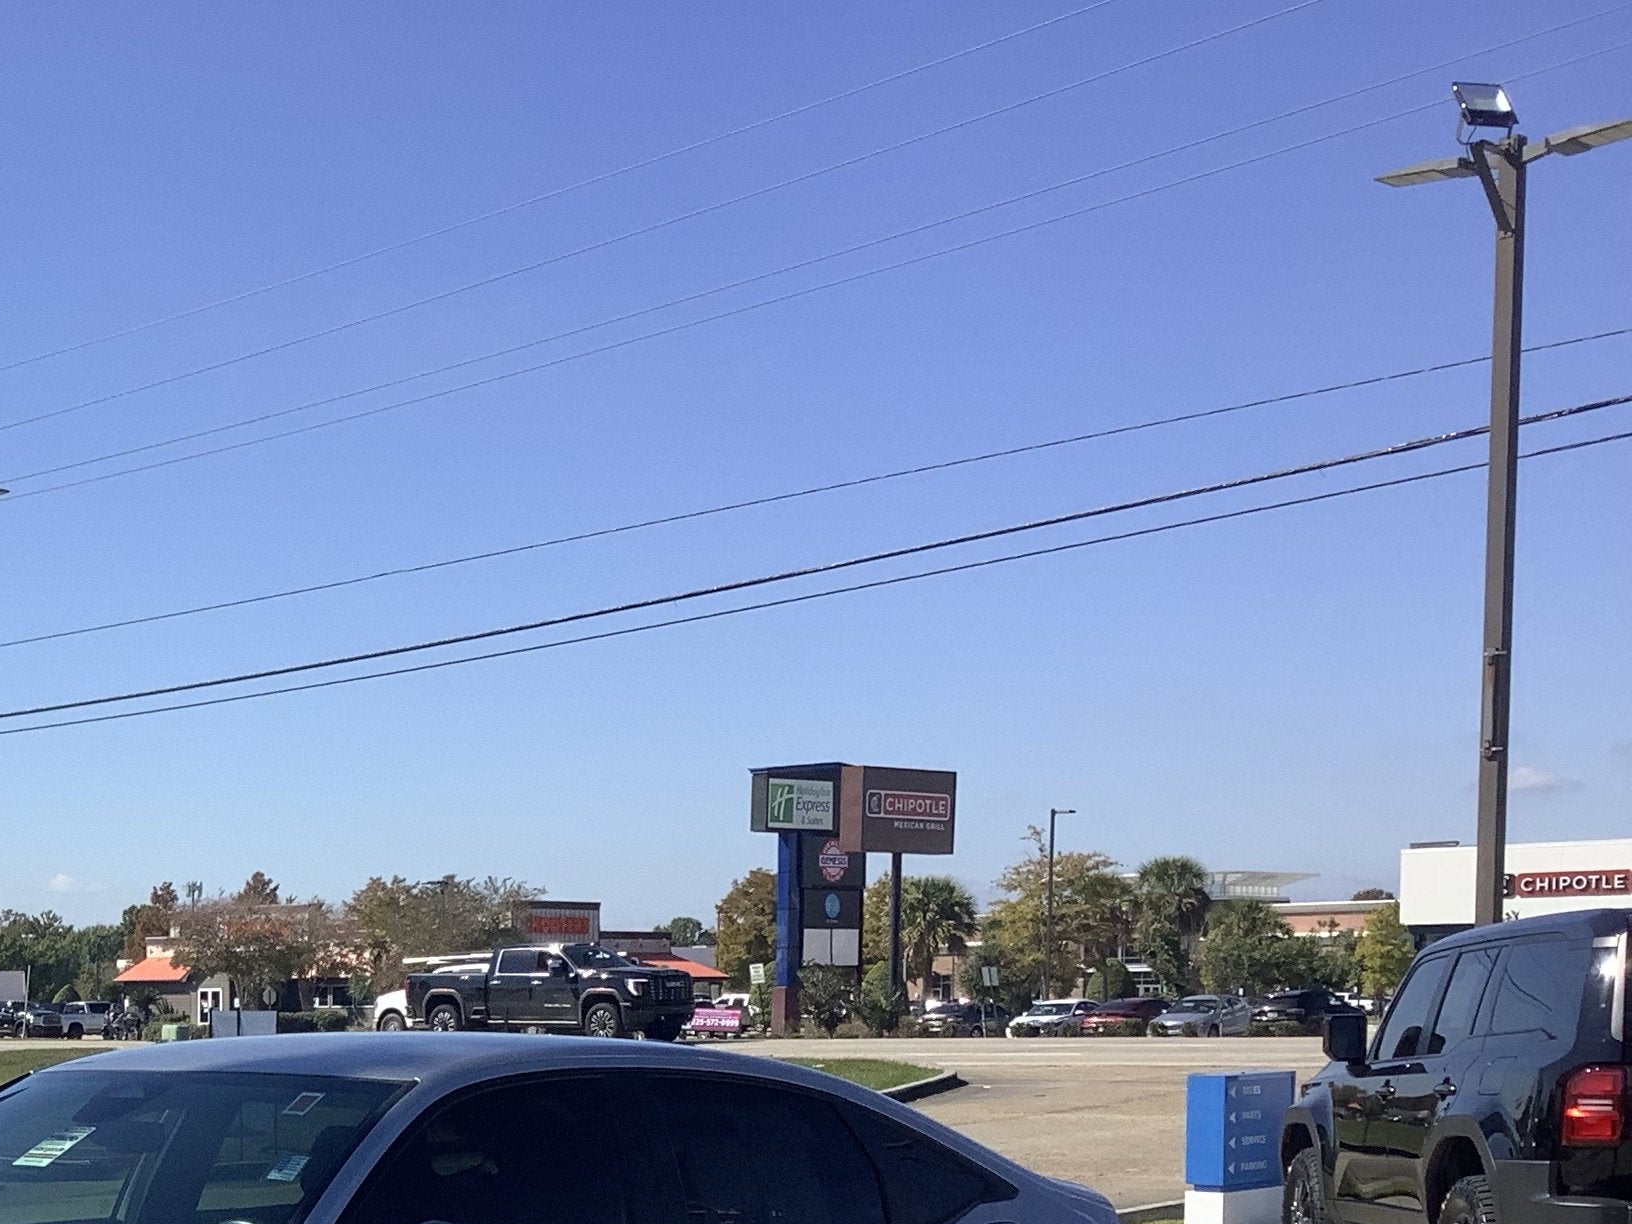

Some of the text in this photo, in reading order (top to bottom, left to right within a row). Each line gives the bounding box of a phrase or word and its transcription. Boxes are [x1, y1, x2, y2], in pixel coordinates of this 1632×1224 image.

[796, 796, 831, 815] Express
[885, 797, 946, 814] CHIPOTLE
[893, 821, 945, 831] MEXICAN GRILL
[1520, 874, 1626, 892] CHIPOTLE
